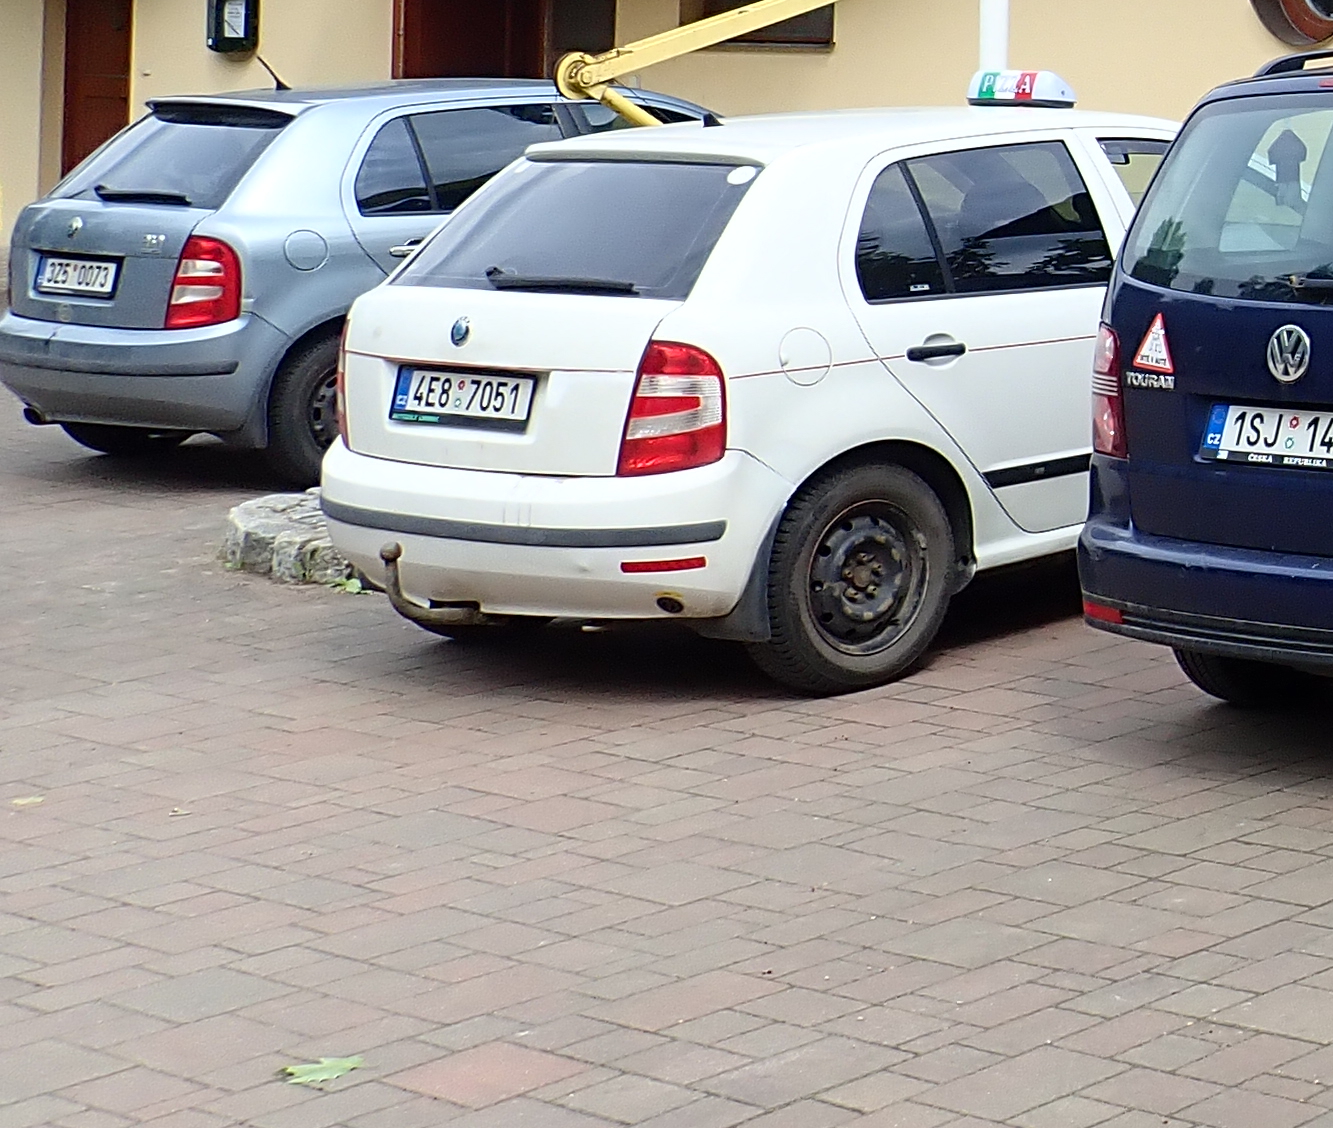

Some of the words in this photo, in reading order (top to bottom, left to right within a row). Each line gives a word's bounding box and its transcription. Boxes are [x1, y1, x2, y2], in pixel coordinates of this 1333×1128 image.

[982, 74, 1031, 95] PIZZA
[1126, 372, 1175, 389] TOURAN
[413, 375, 453, 408] 4E8
[465, 379, 520, 415] 7051
[1207, 433, 1221, 445] CZ
[1233, 411, 1284, 447] 1SJ
